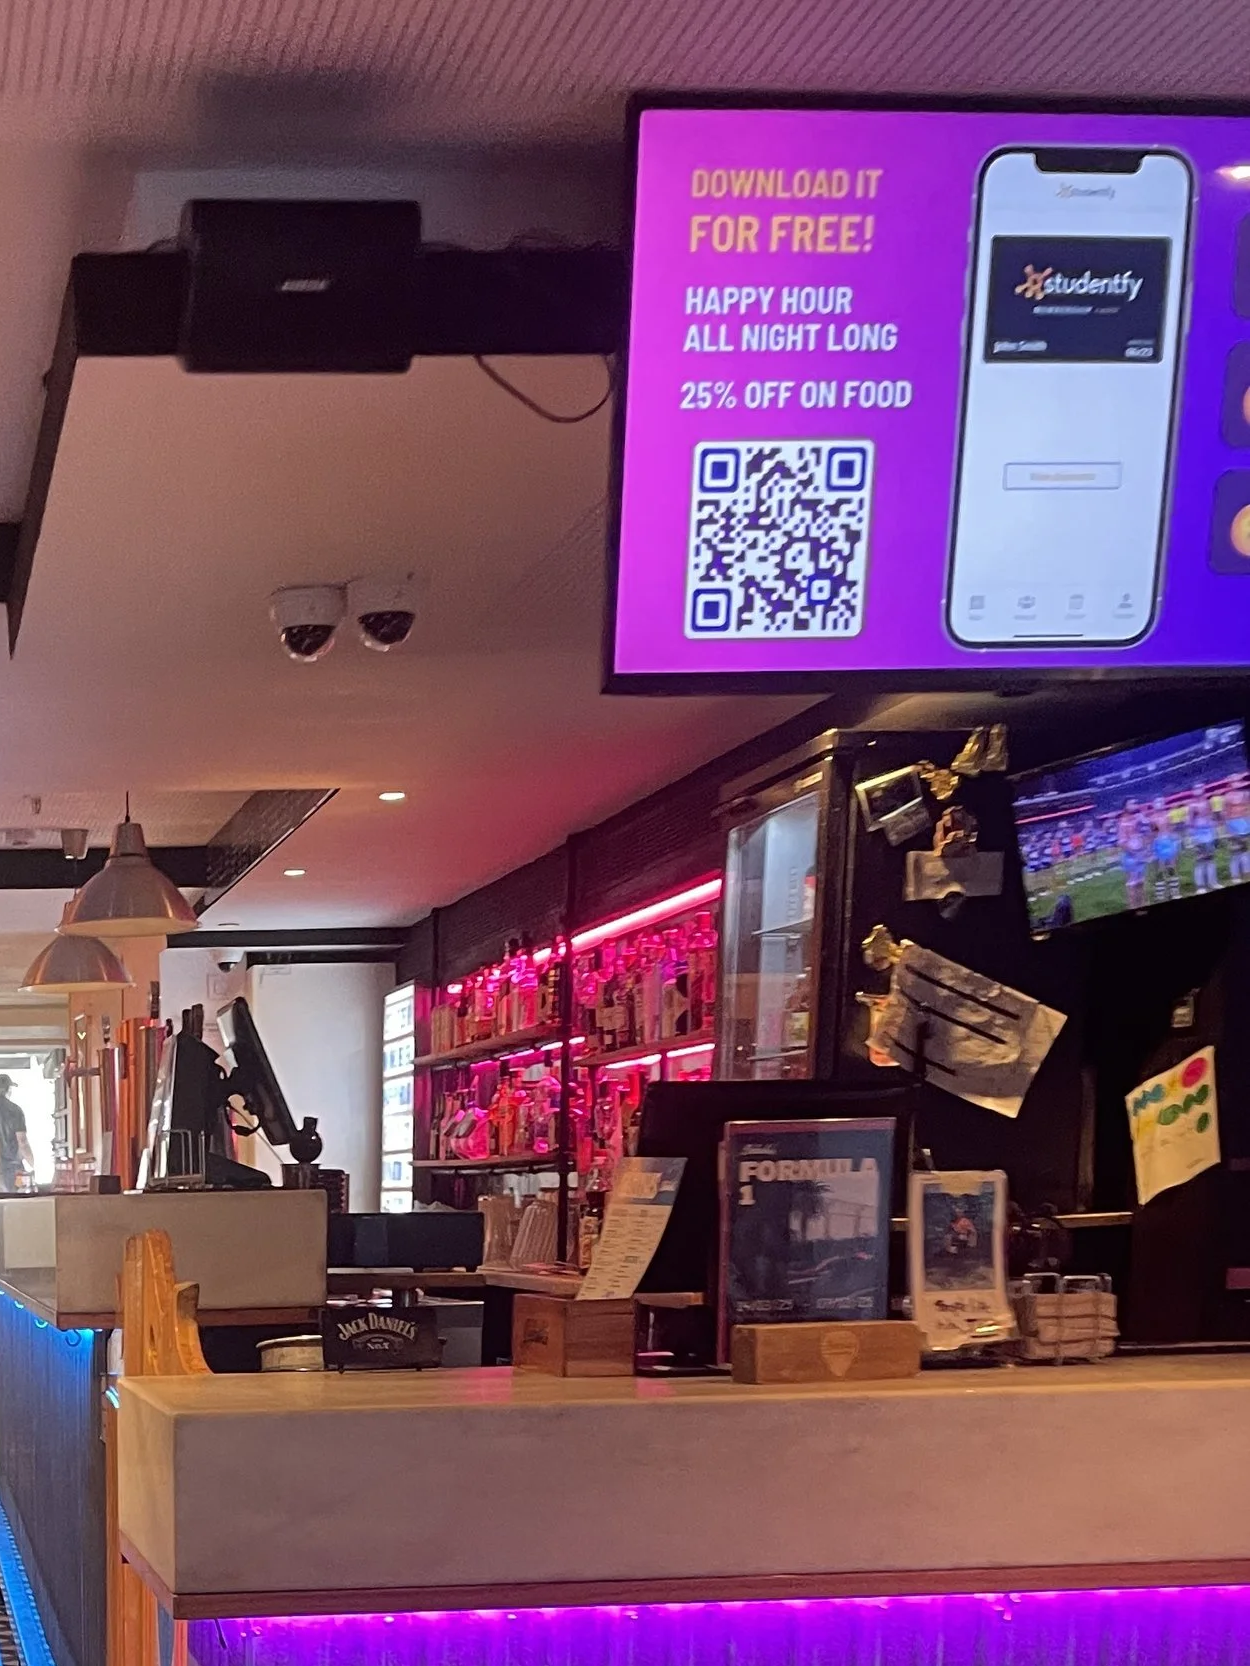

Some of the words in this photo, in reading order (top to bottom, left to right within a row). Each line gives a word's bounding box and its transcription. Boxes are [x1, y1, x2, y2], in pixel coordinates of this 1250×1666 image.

[691, 169, 850, 199] DOWNLOAD
[855, 169, 884, 198] IT
[689, 215, 760, 253] FOR
[769, 215, 876, 253] FREE!
[685, 286, 775, 315] HAPPY
[780, 286, 853, 315] HOUR
[682, 323, 735, 352] ALL
[741, 323, 822, 352] NIGHT
[826, 323, 899, 352] LONG
[679, 380, 737, 409] 25%
[744, 380, 796, 409] OFF
[800, 380, 839, 409] ON
[843, 379, 914, 409] FOOD
[739, 1157, 878, 1183] FORMULA
[738, 1185, 756, 1206] 1
[337, 1317, 368, 1341] JACK
[368, 1312, 417, 1340] DANIEL'S
